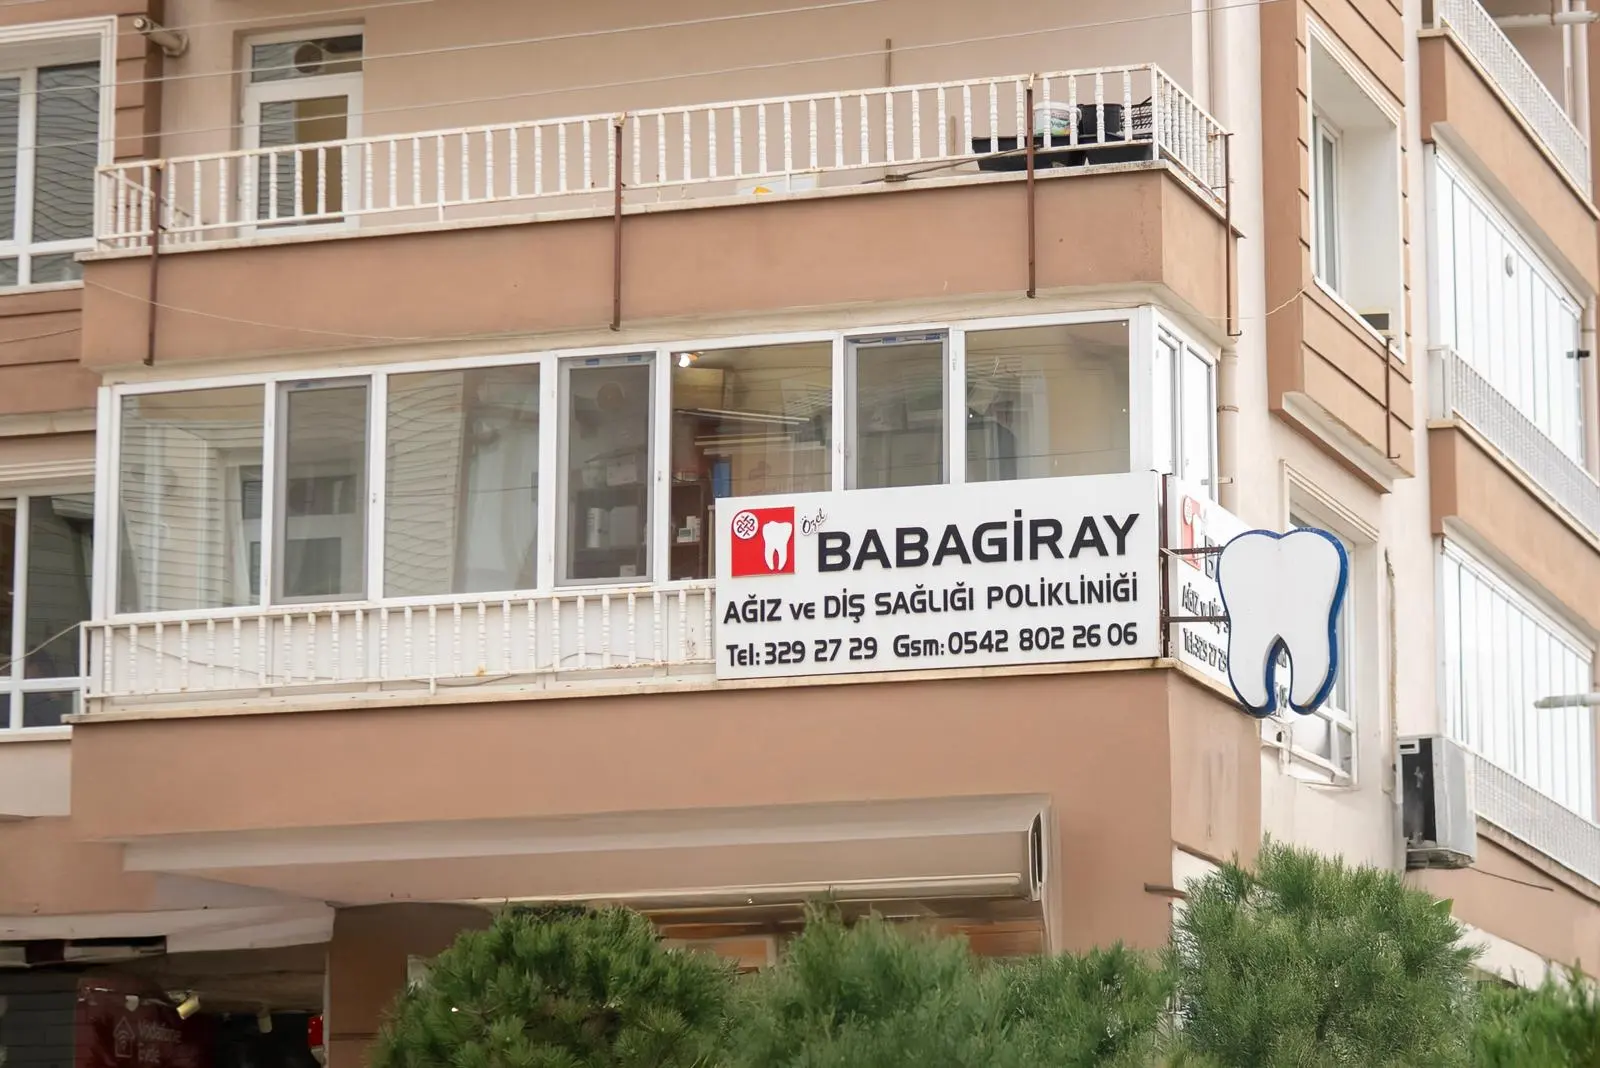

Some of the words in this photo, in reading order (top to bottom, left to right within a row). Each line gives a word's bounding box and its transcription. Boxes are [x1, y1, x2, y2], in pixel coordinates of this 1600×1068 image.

[801, 507, 826, 534] Özel
[817, 508, 1140, 573] BABAGİRAY
[723, 594, 782, 625] AĞIZ
[790, 602, 816, 621] ve
[824, 587, 865, 624] DİŞ
[875, 581, 974, 616] SAĞLIĞI
[987, 571, 1138, 610] POLİKLİNİĞİ
[814, 639, 842, 663] 27
[850, 637, 878, 661] 29
[1019, 627, 1065, 652] 802
[1073, 624, 1102, 649] 26
[1107, 622, 1138, 647] 06
